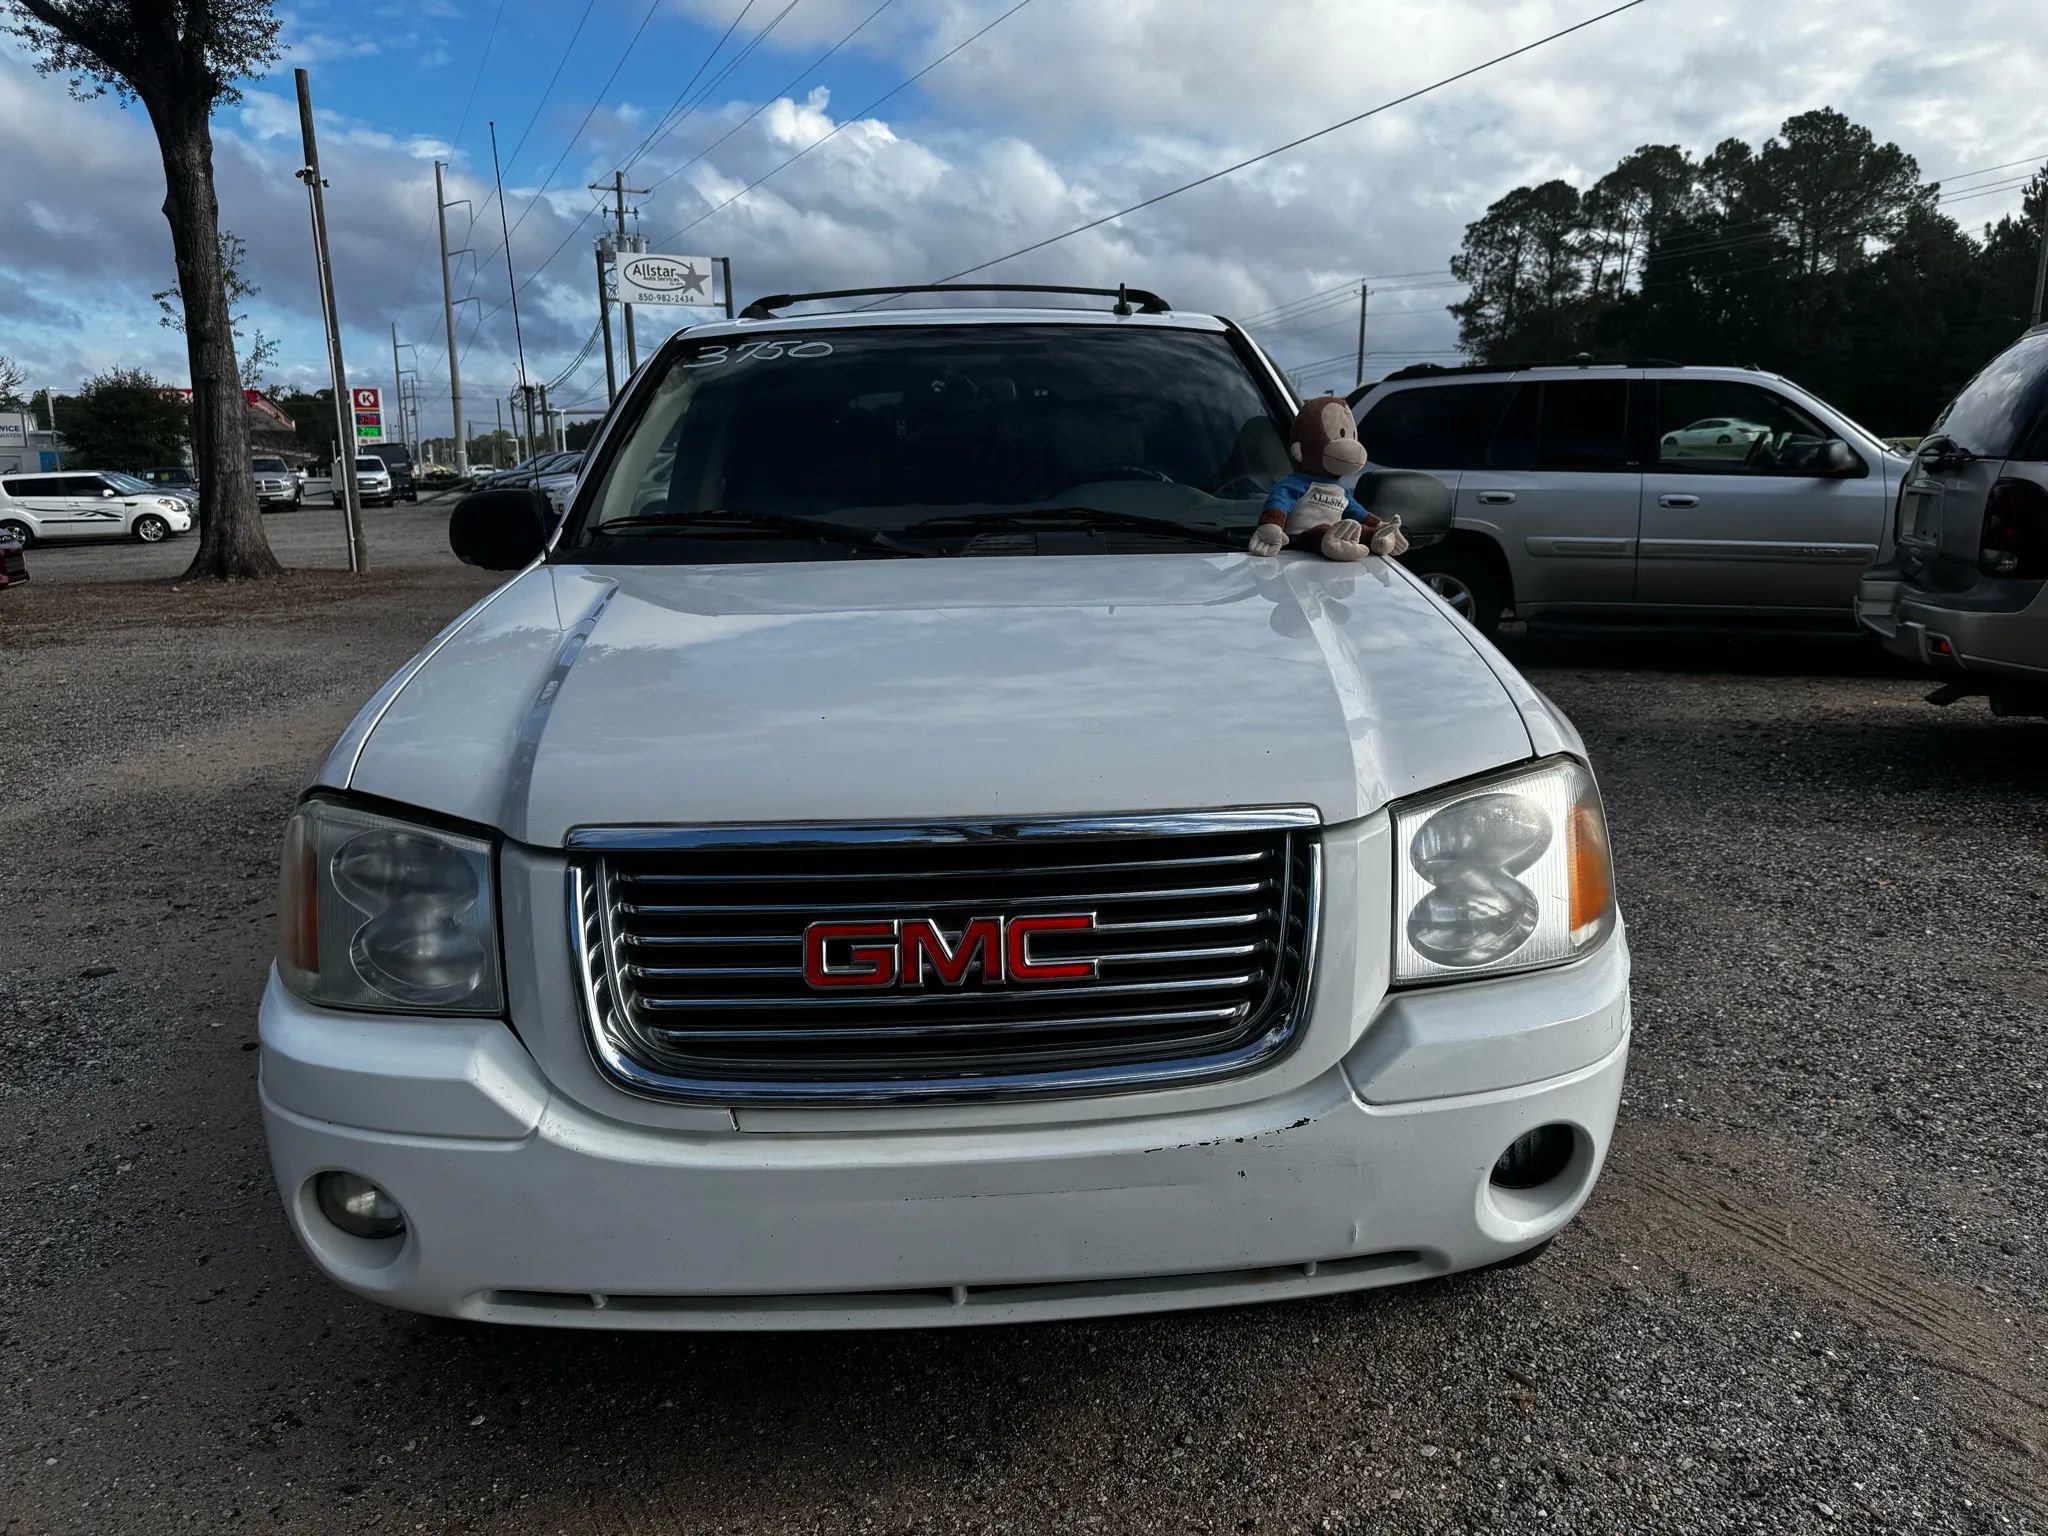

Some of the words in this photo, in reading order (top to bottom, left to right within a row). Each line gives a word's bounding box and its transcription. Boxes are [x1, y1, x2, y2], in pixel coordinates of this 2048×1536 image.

[633, 263, 676, 278] Allstar
[638, 293, 694, 303] 850-982-2434
[683, 340, 834, 368] 3750
[362, 394, 373, 405] K
[802, 911, 1100, 991] GMC
